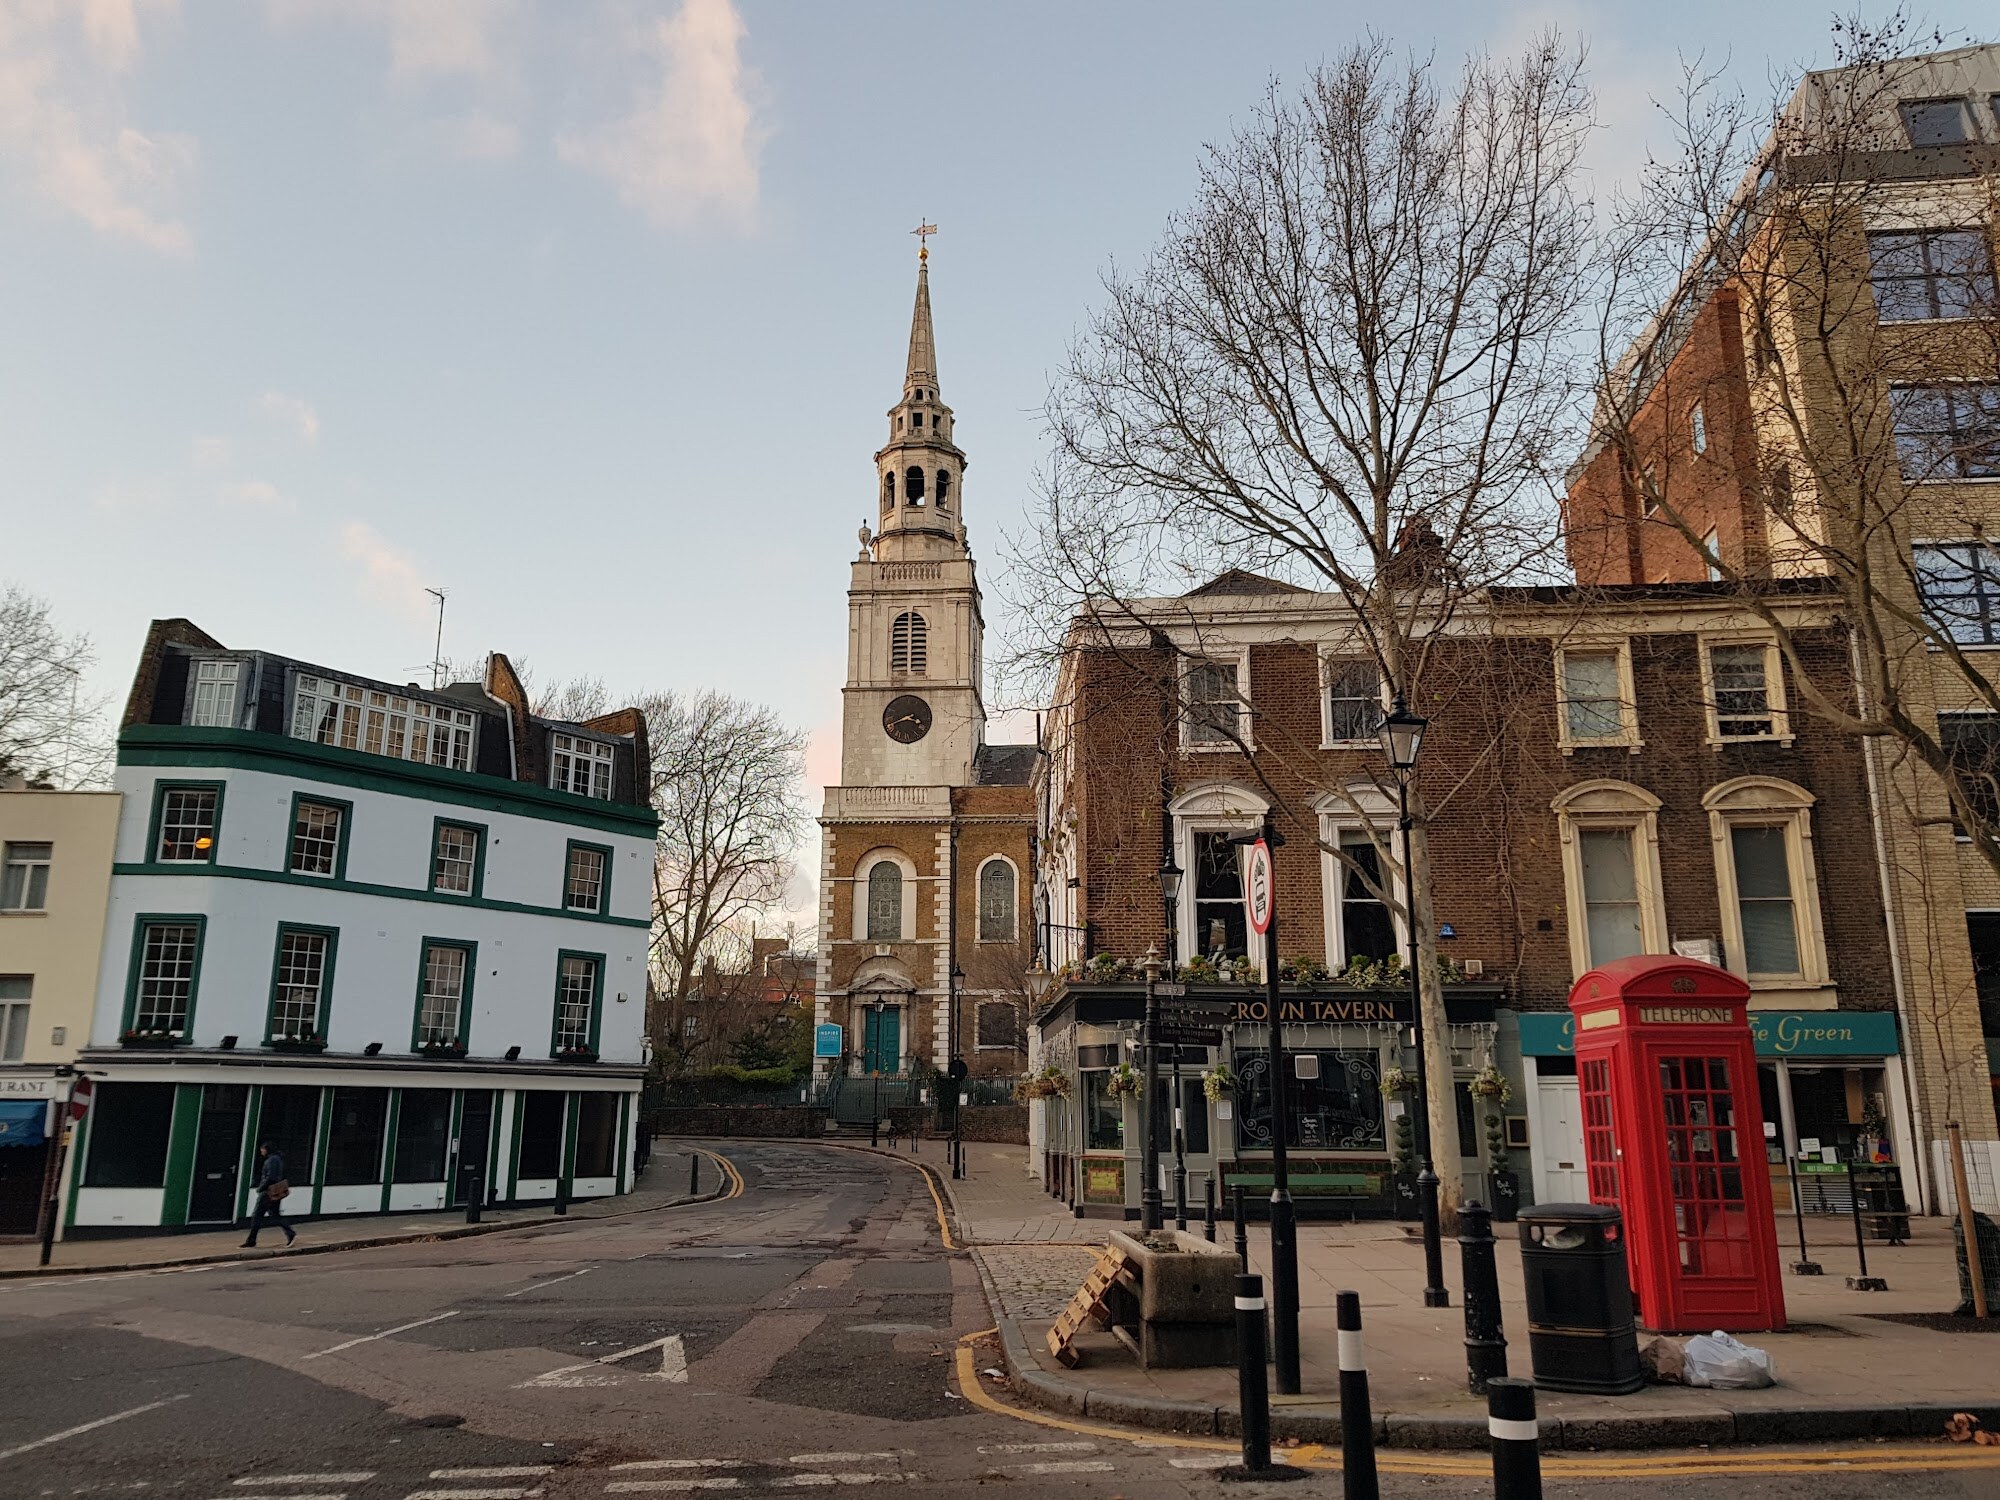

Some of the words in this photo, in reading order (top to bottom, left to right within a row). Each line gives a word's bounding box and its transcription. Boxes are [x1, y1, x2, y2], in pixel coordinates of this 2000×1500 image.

[1309, 1001, 1395, 1020] TAVERN
[1640, 1008, 1731, 1022] TELEPHONE
[1182, 1027, 1216, 1037] Metropolitan
[1774, 1015, 1853, 1052] Green
